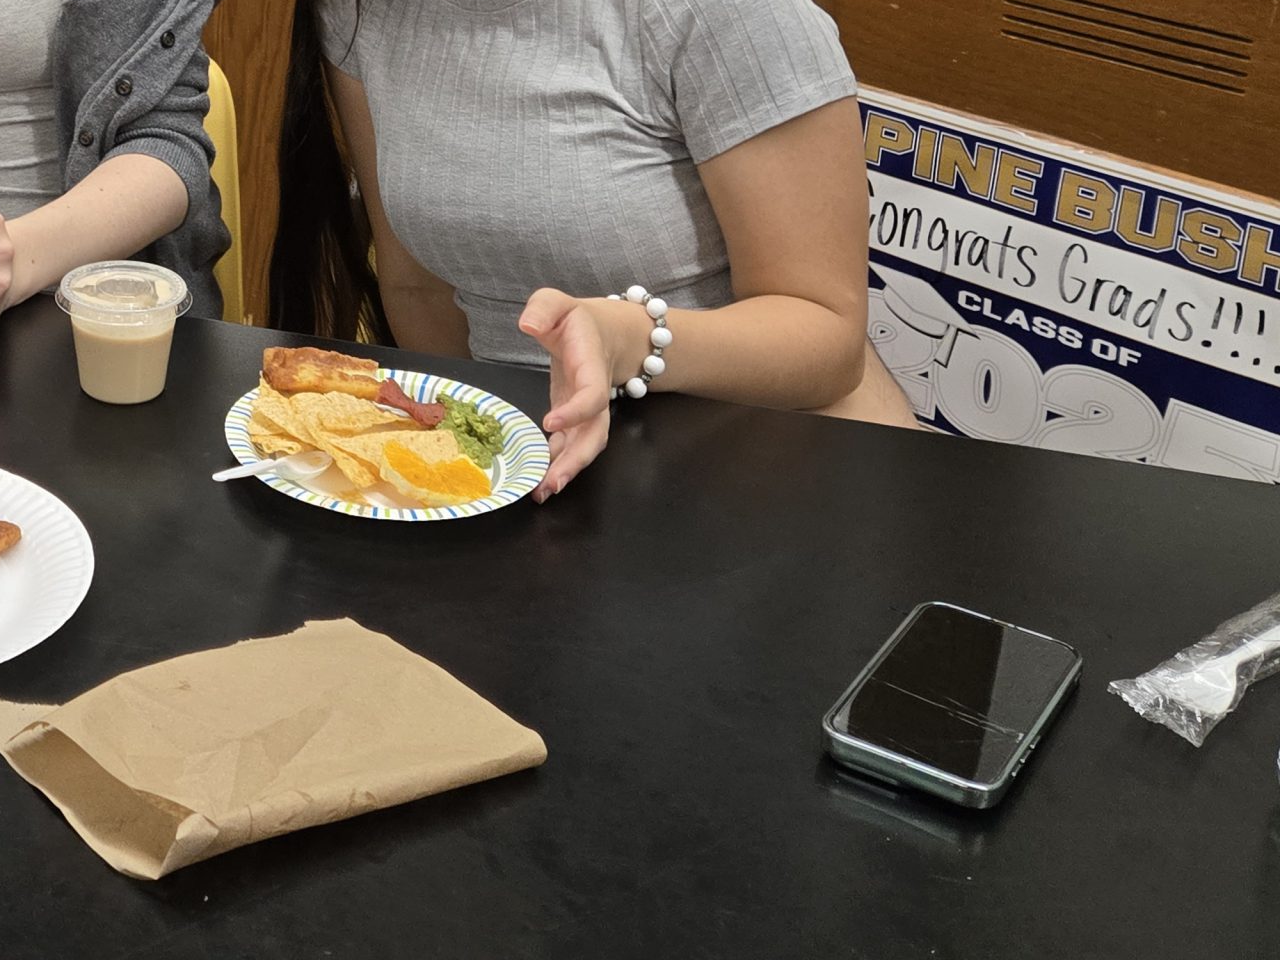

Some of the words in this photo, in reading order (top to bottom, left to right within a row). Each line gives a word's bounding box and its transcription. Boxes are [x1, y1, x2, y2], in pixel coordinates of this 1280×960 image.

[864, 109, 1045, 217] PINE
[1052, 167, 1280, 292] BUSH
[957, 289, 1084, 350] CLASS
[1091, 338, 1142, 368] OF
